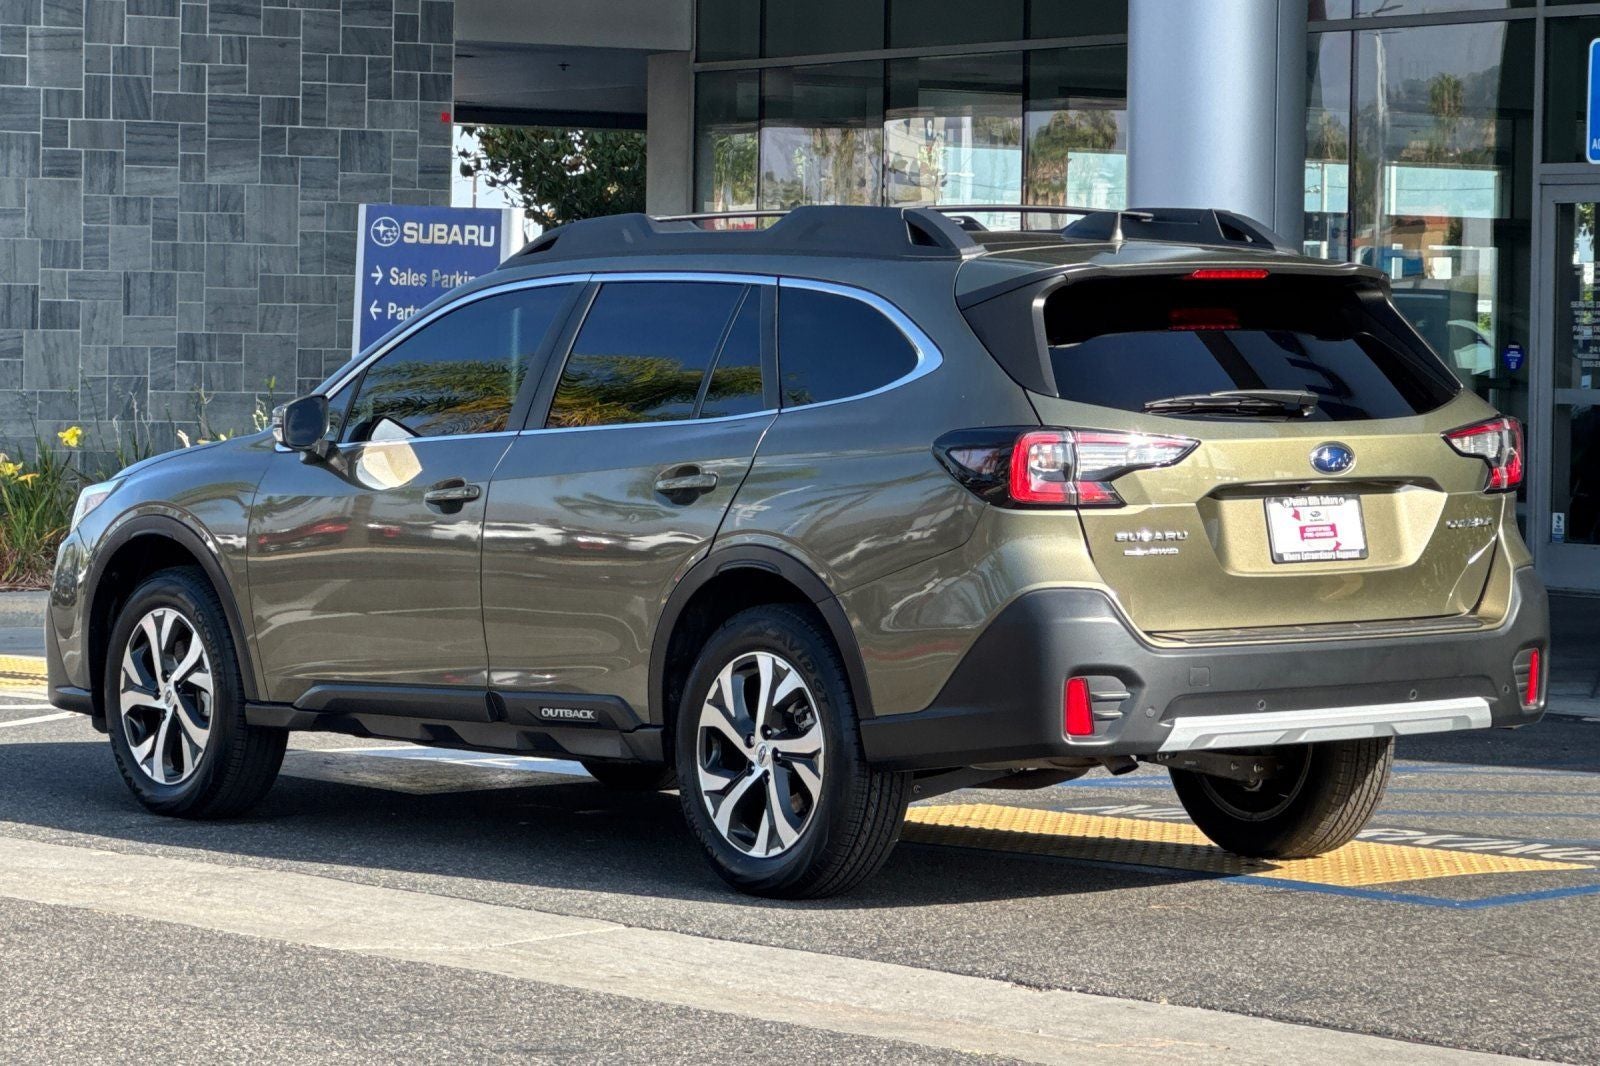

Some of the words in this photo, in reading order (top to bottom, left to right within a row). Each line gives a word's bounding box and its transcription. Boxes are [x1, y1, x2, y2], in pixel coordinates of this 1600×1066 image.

[403, 222, 495, 247] SUBARU
[389, 267, 427, 287] Sales
[431, 269, 477, 288] Parki
[1115, 530, 1188, 542] SUBARU
[541, 707, 595, 719] OUTBACK
